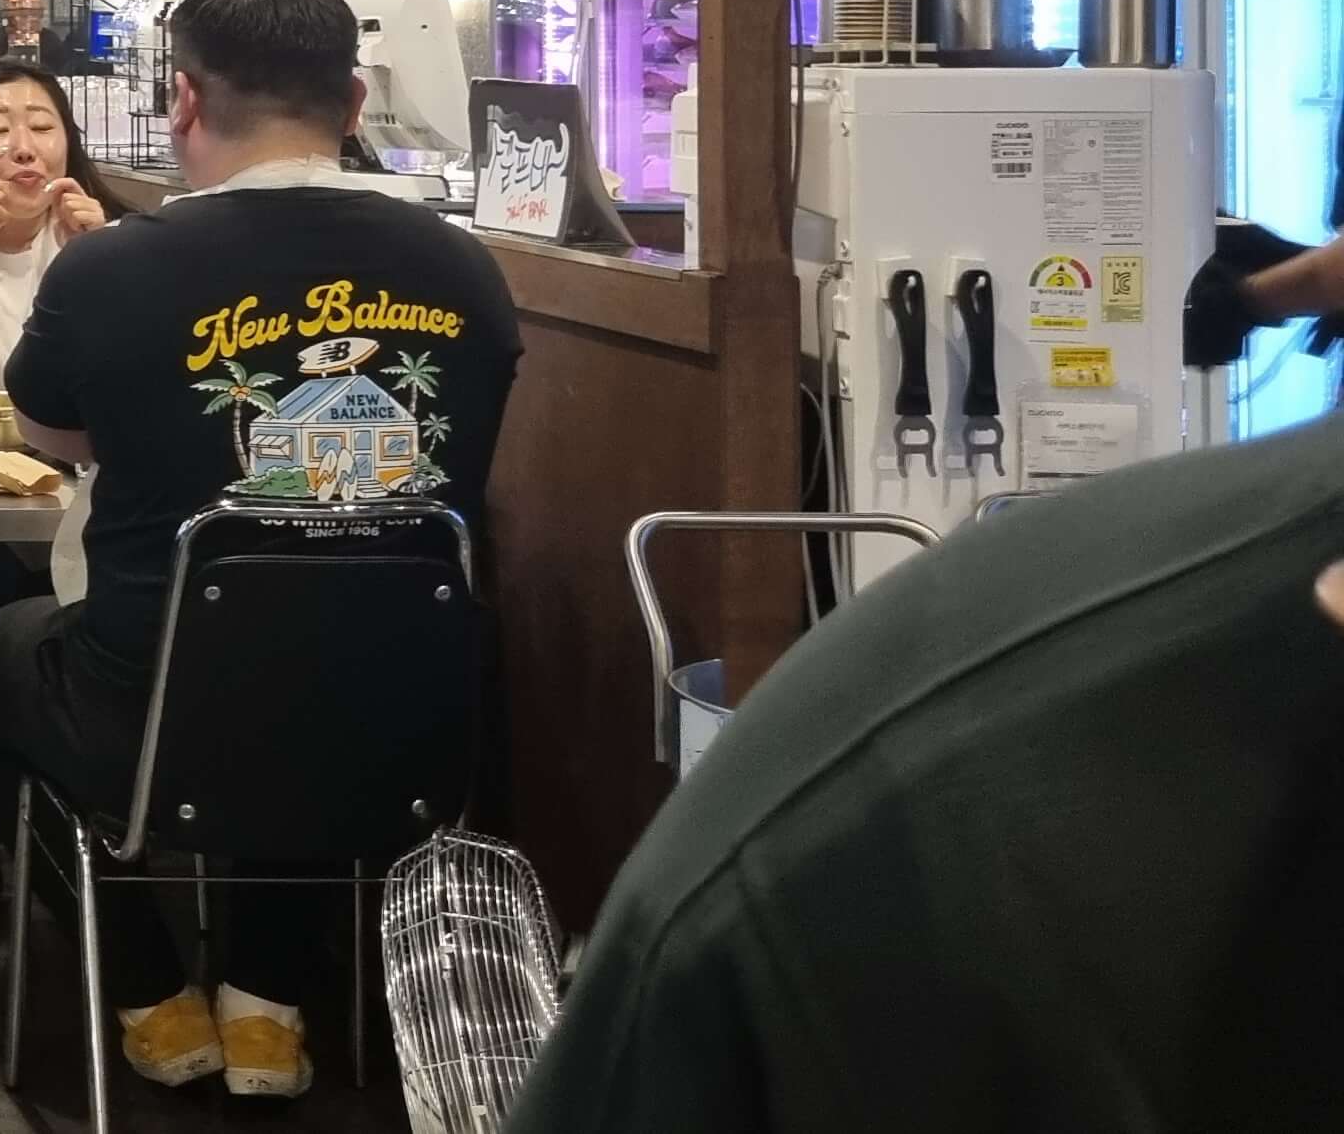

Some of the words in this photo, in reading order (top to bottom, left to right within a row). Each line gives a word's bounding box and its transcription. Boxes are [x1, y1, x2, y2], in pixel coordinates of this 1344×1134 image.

[1056, 276, 1065, 287] 3
[187, 295, 291, 371] New
[298, 279, 460, 338] Balance
[346, 394, 380, 407] NEW
[330, 406, 395, 420] BALANCE
[305, 527, 345, 538] SINCE
[348, 526, 380, 537] 1906
